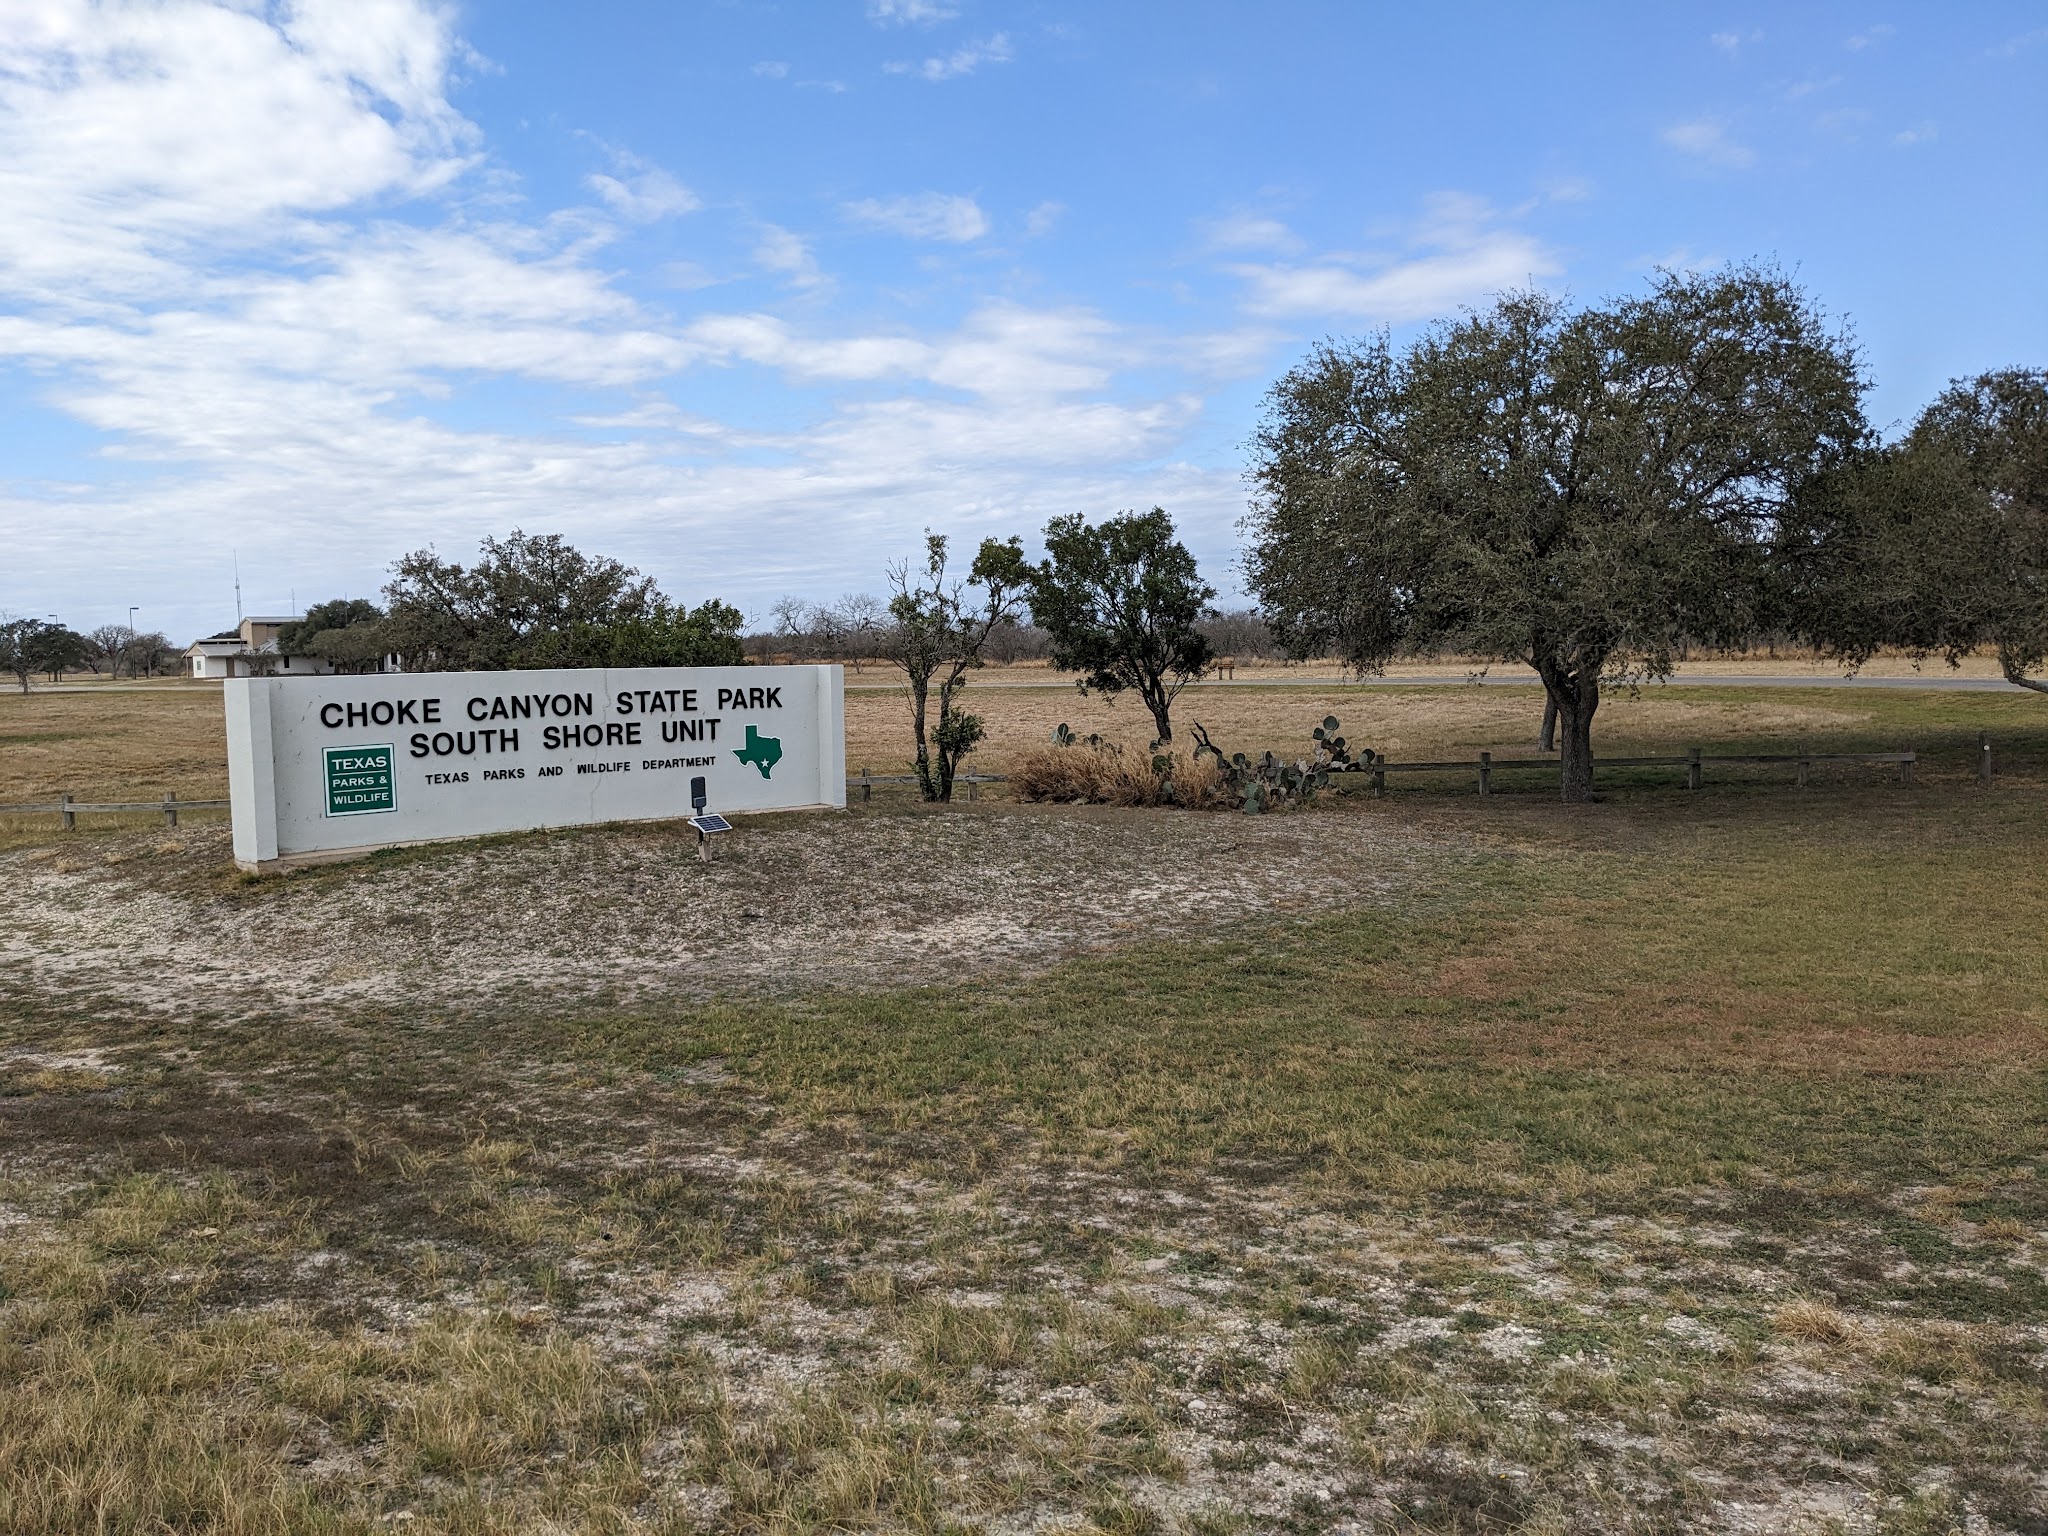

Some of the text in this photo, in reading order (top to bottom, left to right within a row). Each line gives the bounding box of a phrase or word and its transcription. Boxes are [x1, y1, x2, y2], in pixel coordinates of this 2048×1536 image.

[319, 686, 783, 729] CHOKE CANYON STATE PARK
[409, 718, 721, 759] SOUTH SHORE UNIT
[331, 756, 388, 771] TEXAS
[424, 755, 717, 785] TEXAS PARKS AND WILDLIFE DEPARTMENT
[332, 775, 388, 788] PARKS &
[333, 792, 390, 805] WILDLIFE
